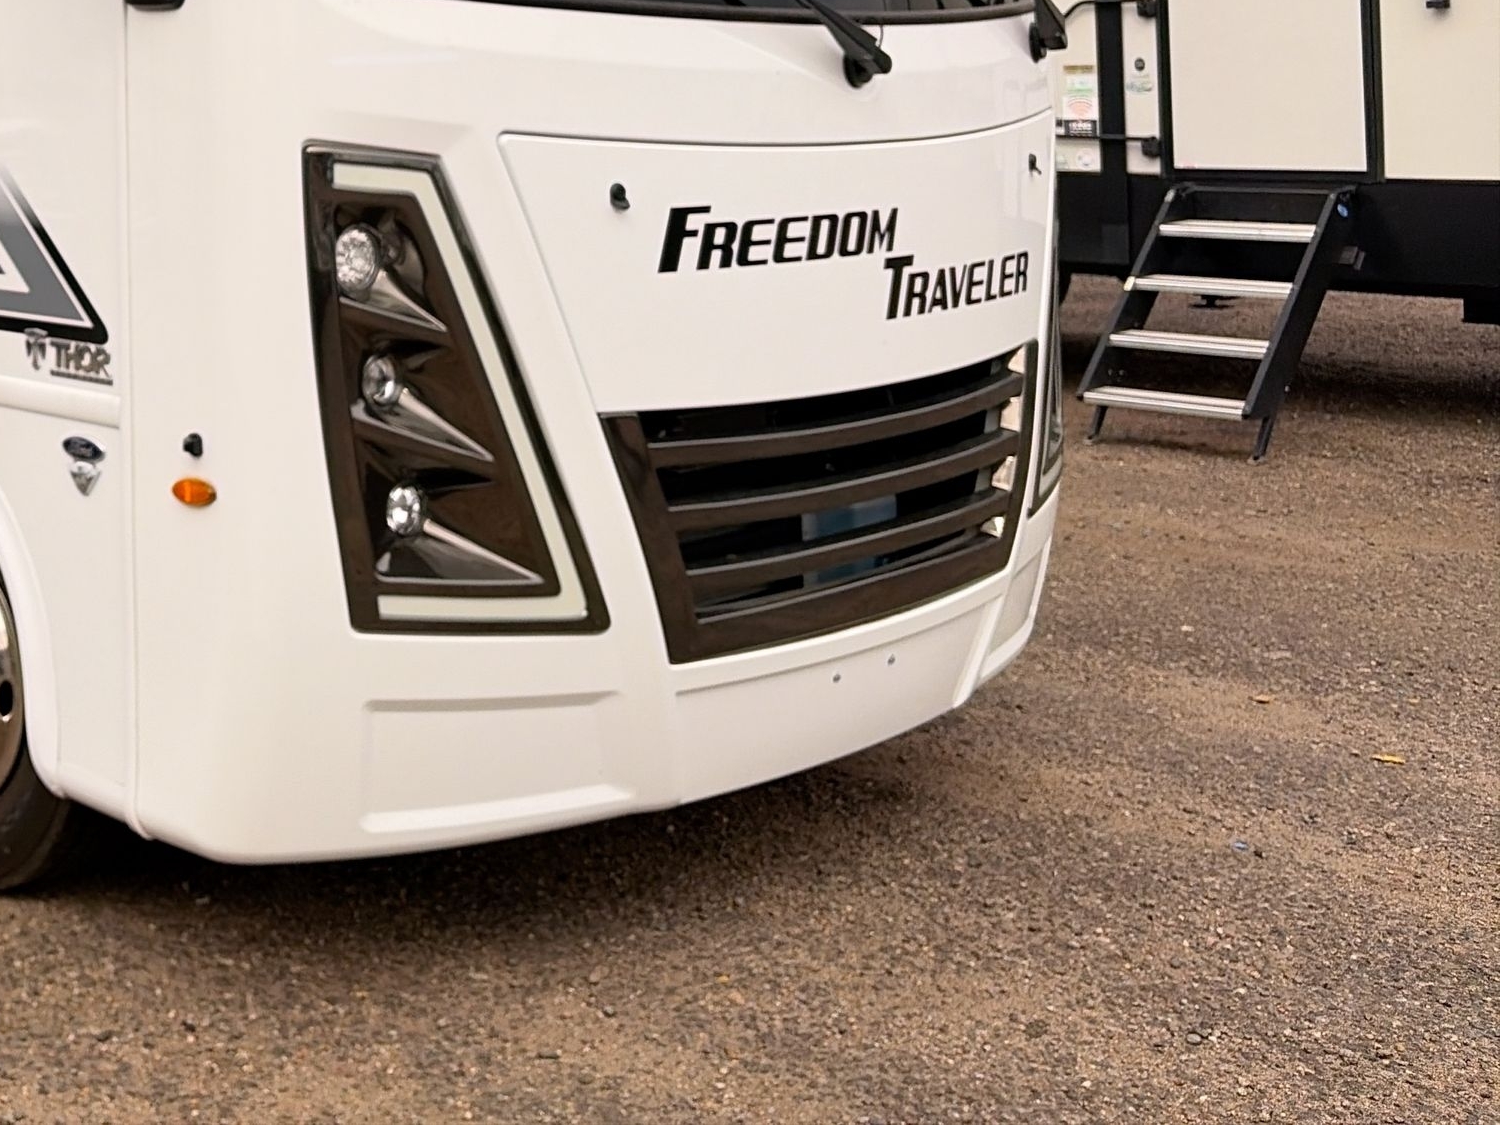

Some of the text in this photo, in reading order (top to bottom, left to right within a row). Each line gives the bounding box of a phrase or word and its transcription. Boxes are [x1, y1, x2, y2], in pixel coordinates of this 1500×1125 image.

[657, 205, 899, 274] FREEDOM
[883, 251, 1030, 320] TRAVELER
[49, 338, 111, 377] THOR
